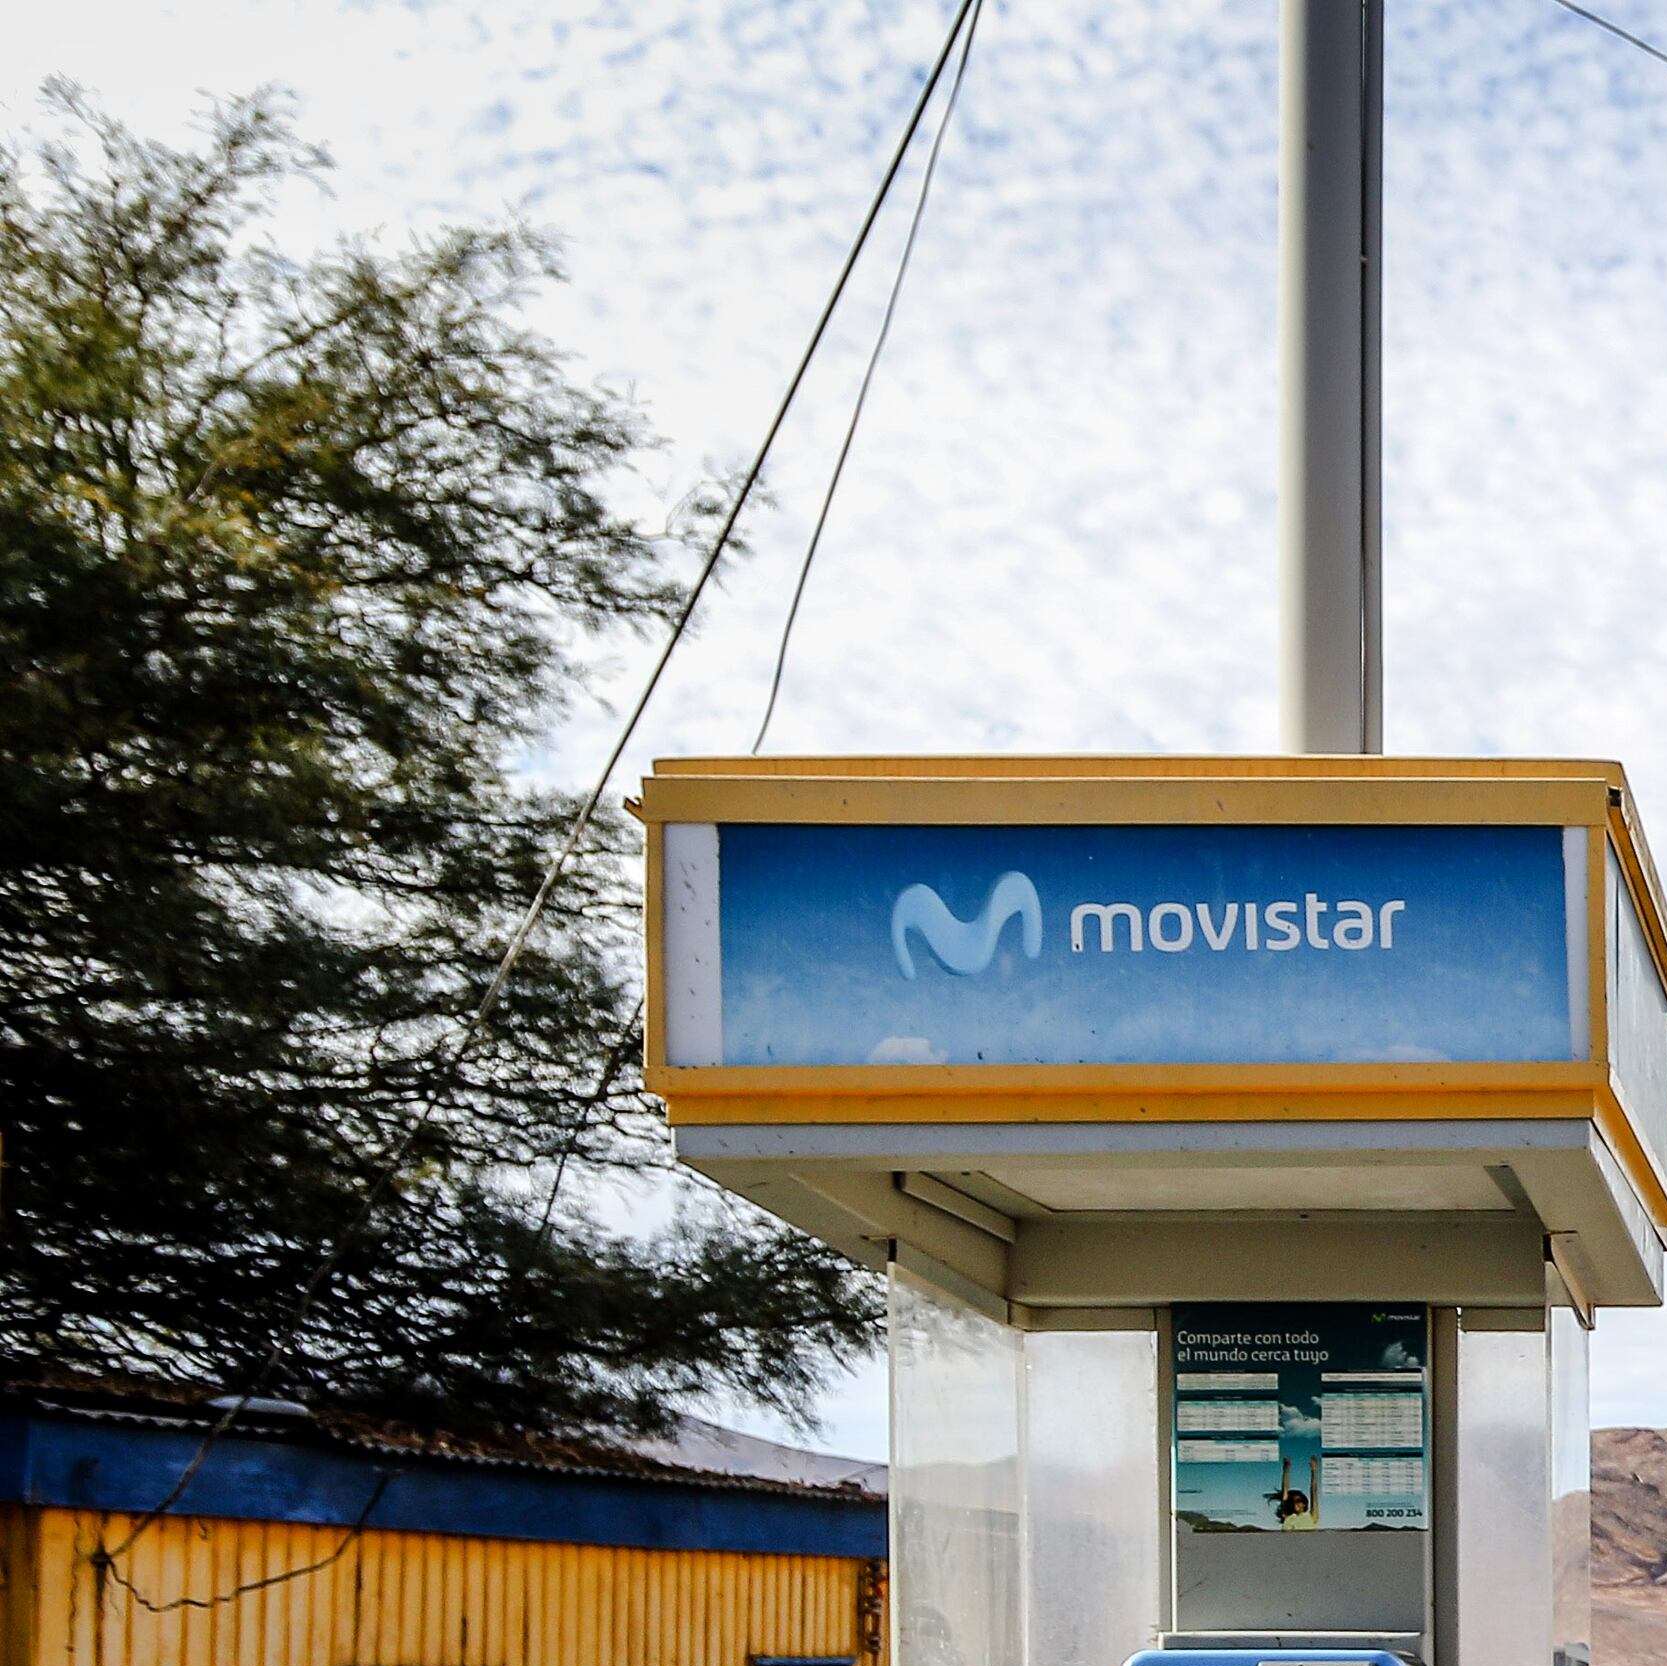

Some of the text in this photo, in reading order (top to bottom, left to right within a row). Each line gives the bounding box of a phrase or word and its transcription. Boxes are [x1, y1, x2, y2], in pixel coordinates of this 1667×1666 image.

[1070, 892, 1406, 953] movistar
[1177, 1330, 1319, 1348] Comparte con todo
[1177, 1347, 1329, 1365] el mundo cerca tuyo
[1386, 1508, 1404, 1518] 200
